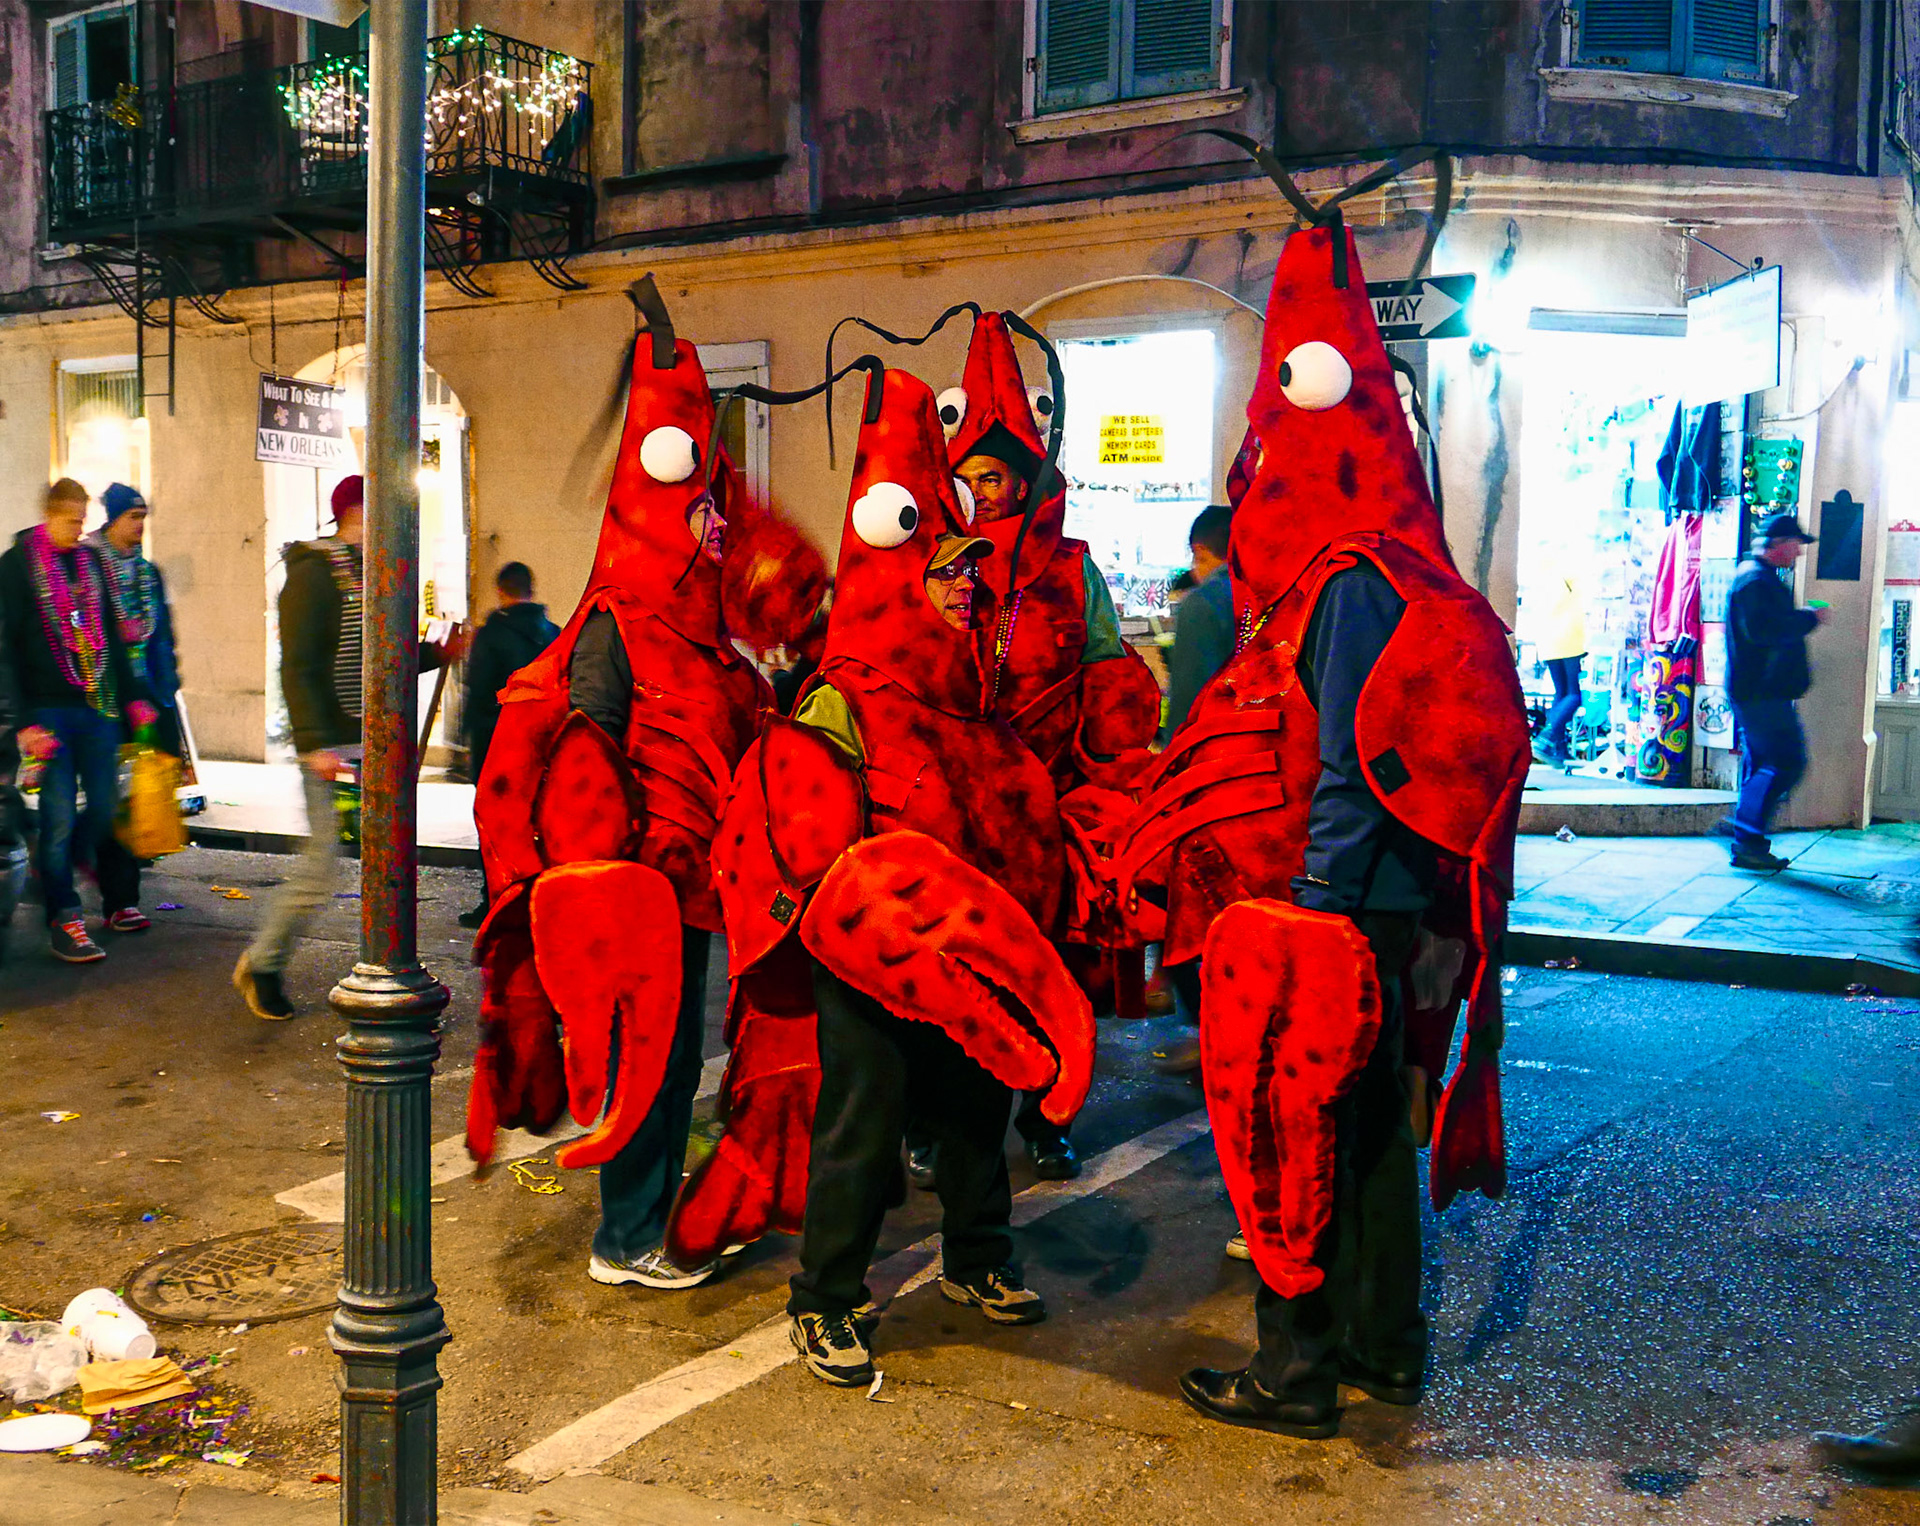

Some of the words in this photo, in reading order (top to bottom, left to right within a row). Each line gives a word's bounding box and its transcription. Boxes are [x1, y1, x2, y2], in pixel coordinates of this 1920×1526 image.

[1376, 297, 1423, 323] WAY
[263, 382, 289, 401] WHAT
[1113, 415, 1126, 424] WE
[1130, 415, 1150, 424] SELL
[259, 432, 285, 452] NEW
[1106, 440, 1132, 450] MEMORY
[1134, 440, 1156, 449] CARDS
[1102, 453, 1129, 462] ATM
[1131, 455, 1162, 463] INSIDE
